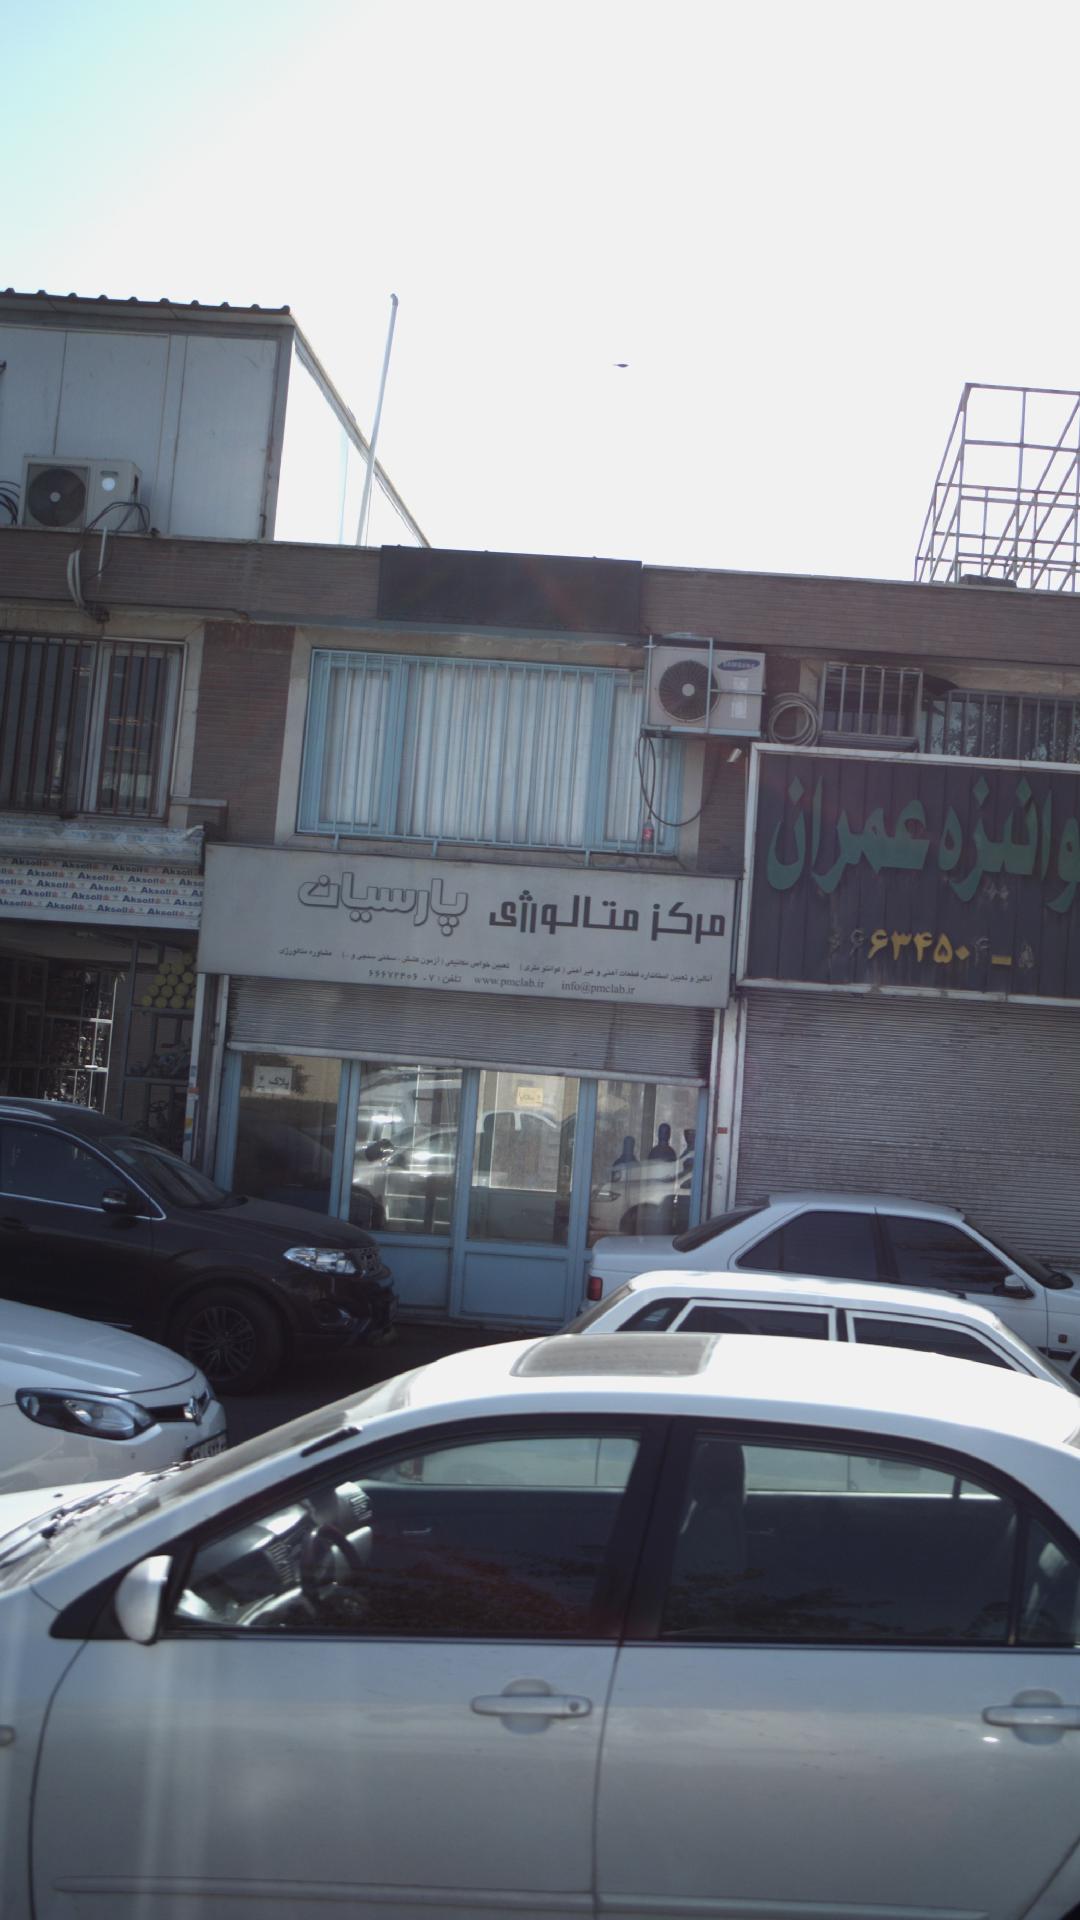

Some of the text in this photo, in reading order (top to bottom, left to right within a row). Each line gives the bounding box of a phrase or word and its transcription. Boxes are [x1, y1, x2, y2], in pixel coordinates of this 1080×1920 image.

[767, 775, 931, 894] عمران
[298, 871, 726, 945] مرکز متالورژی پارسیان
[474, 975, 544, 990] www.pmclab.ir
[561, 980, 636, 995] info@pmclab.ir
